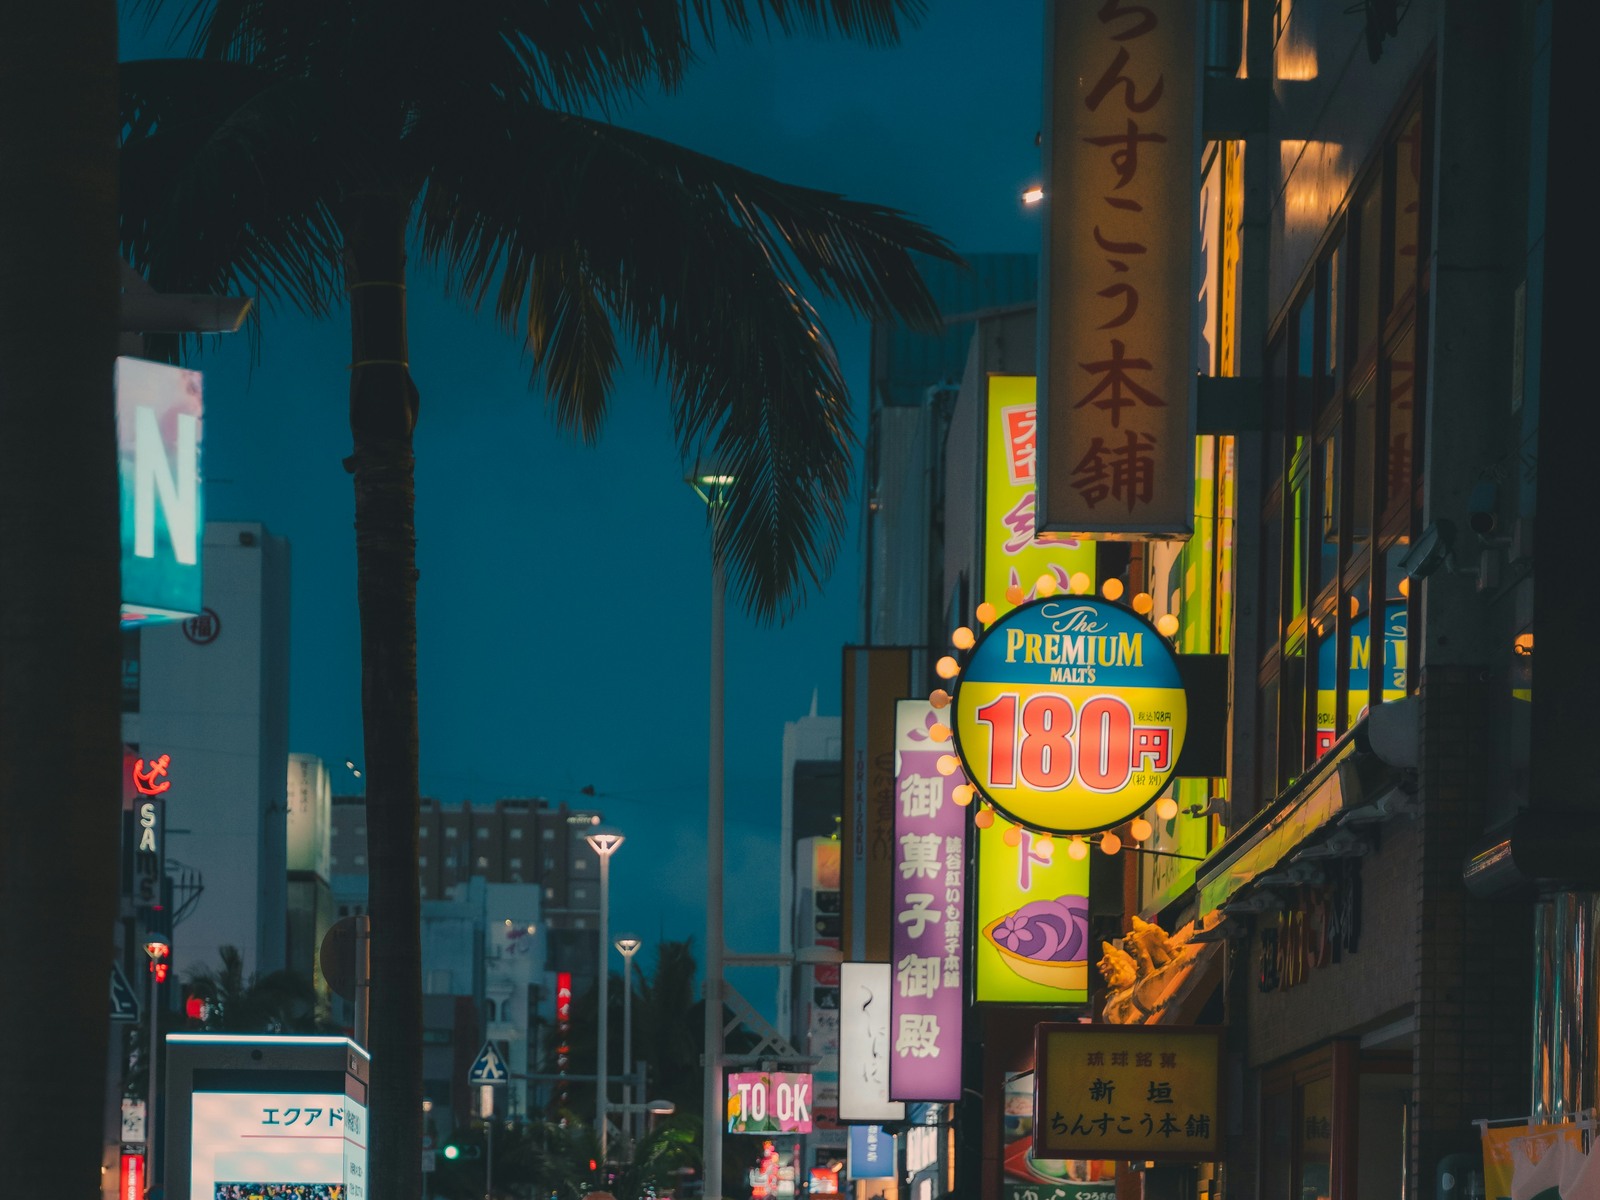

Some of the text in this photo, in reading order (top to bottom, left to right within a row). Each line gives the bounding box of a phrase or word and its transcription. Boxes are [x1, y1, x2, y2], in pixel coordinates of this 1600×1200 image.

[1041, 603, 1108, 634] The
[1005, 628, 1144, 668] PREMIUM
[1050, 665, 1097, 684] MALT'S
[896, 773, 945, 1058] 御菓子御殿
[1086, 1051, 1177, 1069] 琉球銘菓
[737, 1082, 810, 1122] TO OK
[1088, 1077, 1174, 1105] 新垣
[1051, 1111, 1211, 1140] ちんすこう本舗
